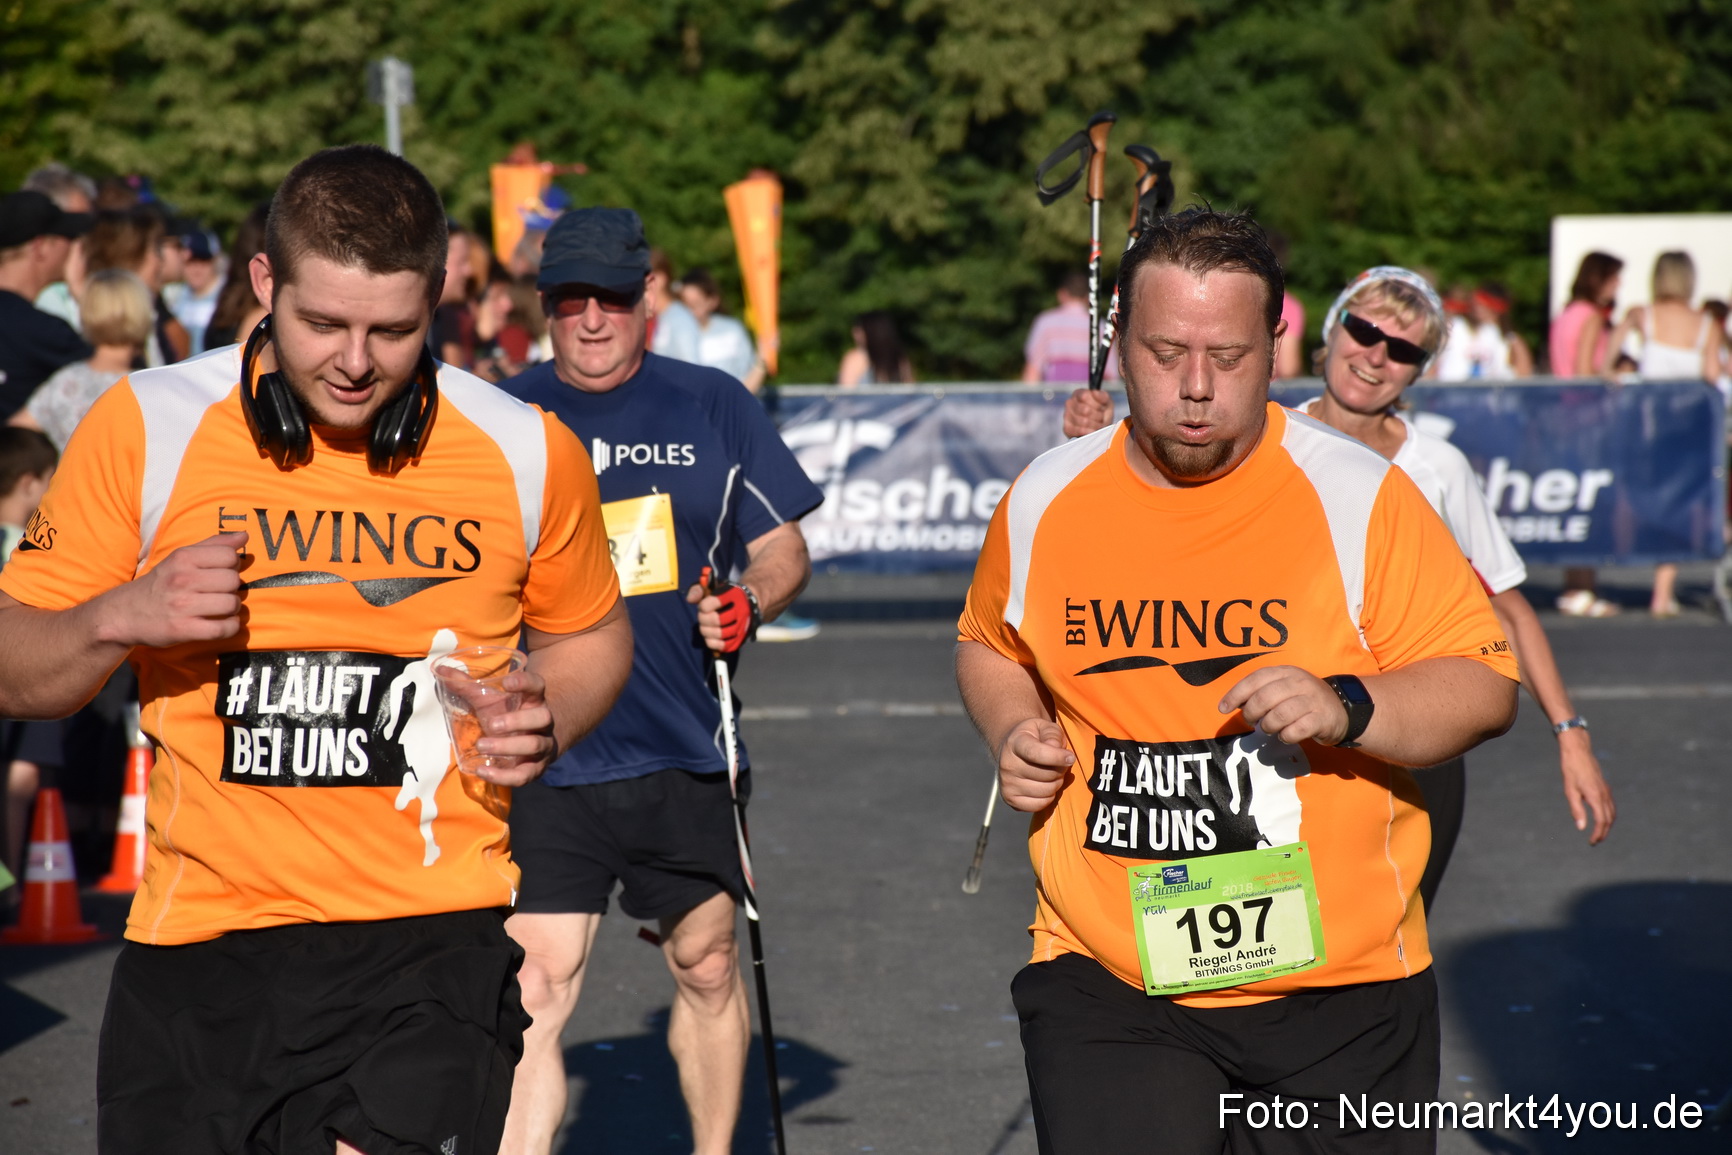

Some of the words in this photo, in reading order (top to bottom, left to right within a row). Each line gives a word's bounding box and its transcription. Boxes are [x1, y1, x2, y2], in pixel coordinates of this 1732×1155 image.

[615, 443, 696, 467] POLES
[253, 508, 482, 573] WINGS
[1066, 597, 1086, 647] BIT
[1089, 598, 1289, 648] WINGS
[232, 726, 283, 776] BEI
[292, 727, 369, 777] UNS
[1092, 802, 1138, 849] BEI
[1149, 808, 1218, 851] UNS
[1153, 877, 1212, 896] firmenlauf
[1222, 882, 1254, 896] 2018
[1176, 896, 1274, 954] 197
[1189, 951, 1232, 968] Riegel
[1236, 944, 1277, 961] André
[1195, 963, 1243, 978] BITWINGS
[1245, 958, 1275, 970] GmbH
